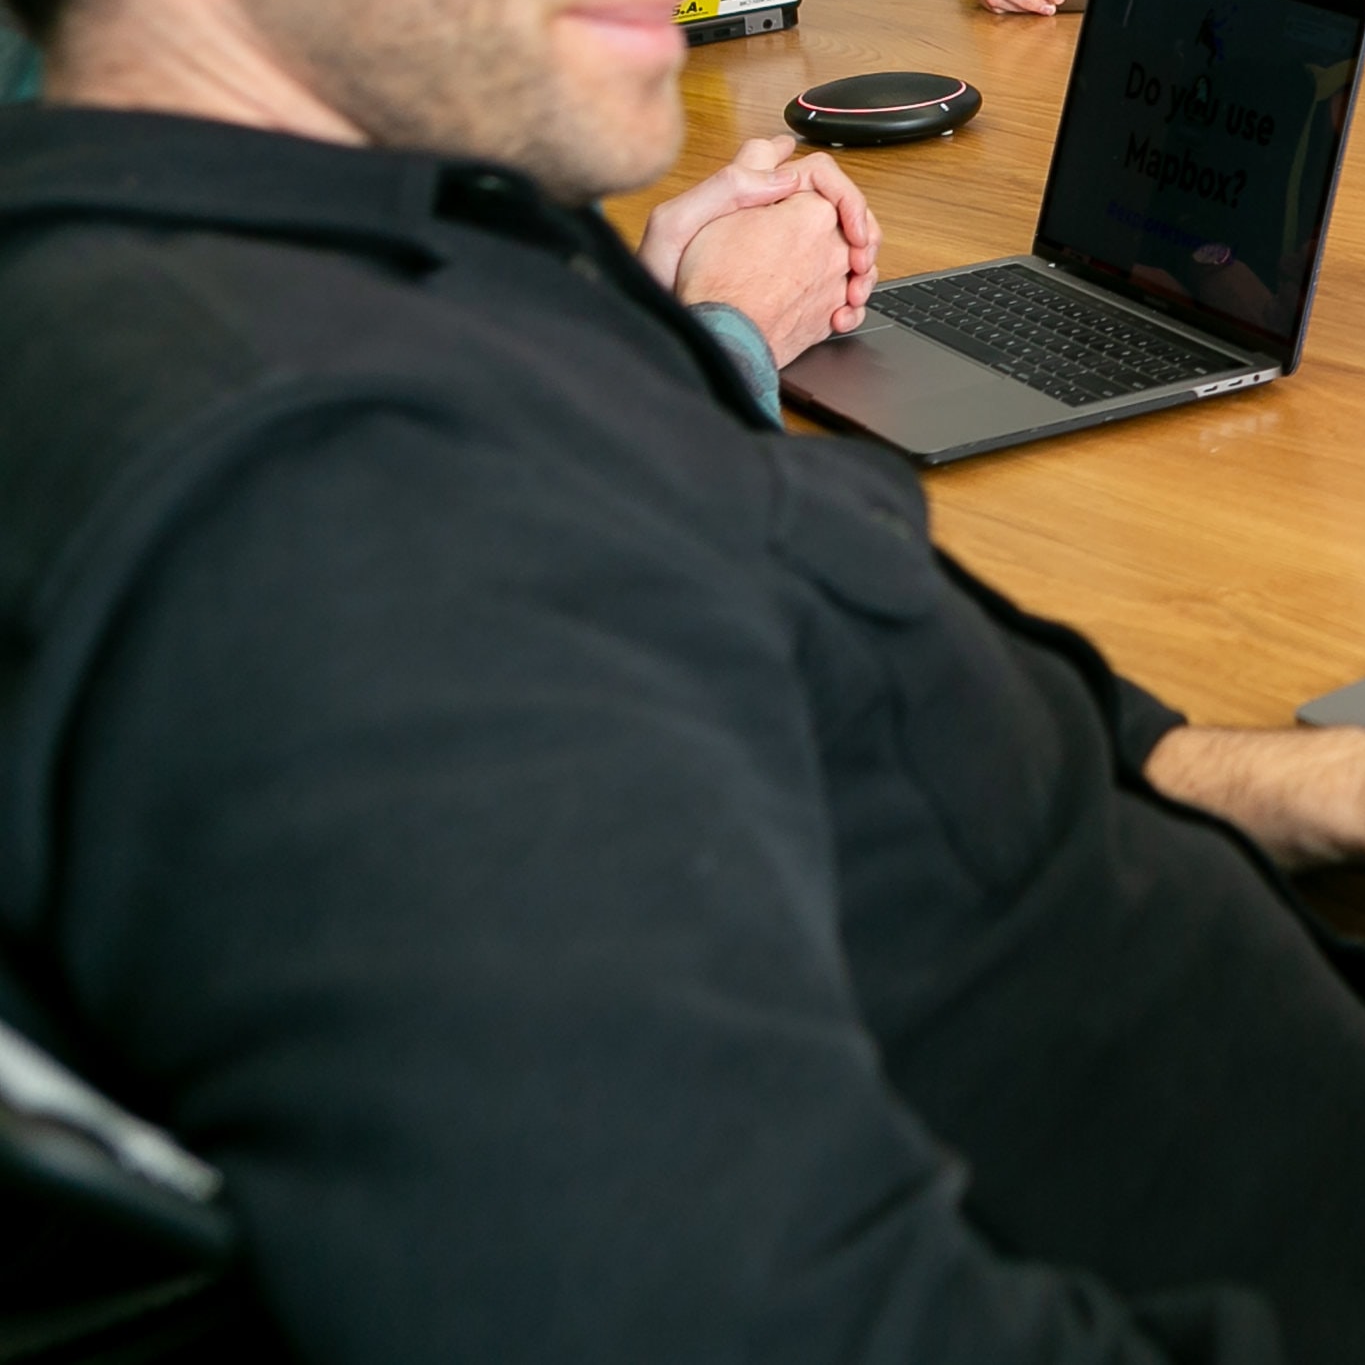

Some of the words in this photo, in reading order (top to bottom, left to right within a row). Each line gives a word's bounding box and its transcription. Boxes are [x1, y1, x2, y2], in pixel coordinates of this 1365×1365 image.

[1124, 61, 1162, 107] Do
[1164, 83, 1220, 128] you
[1225, 102, 1276, 147] use
[1122, 130, 1249, 209] Mapbox?
